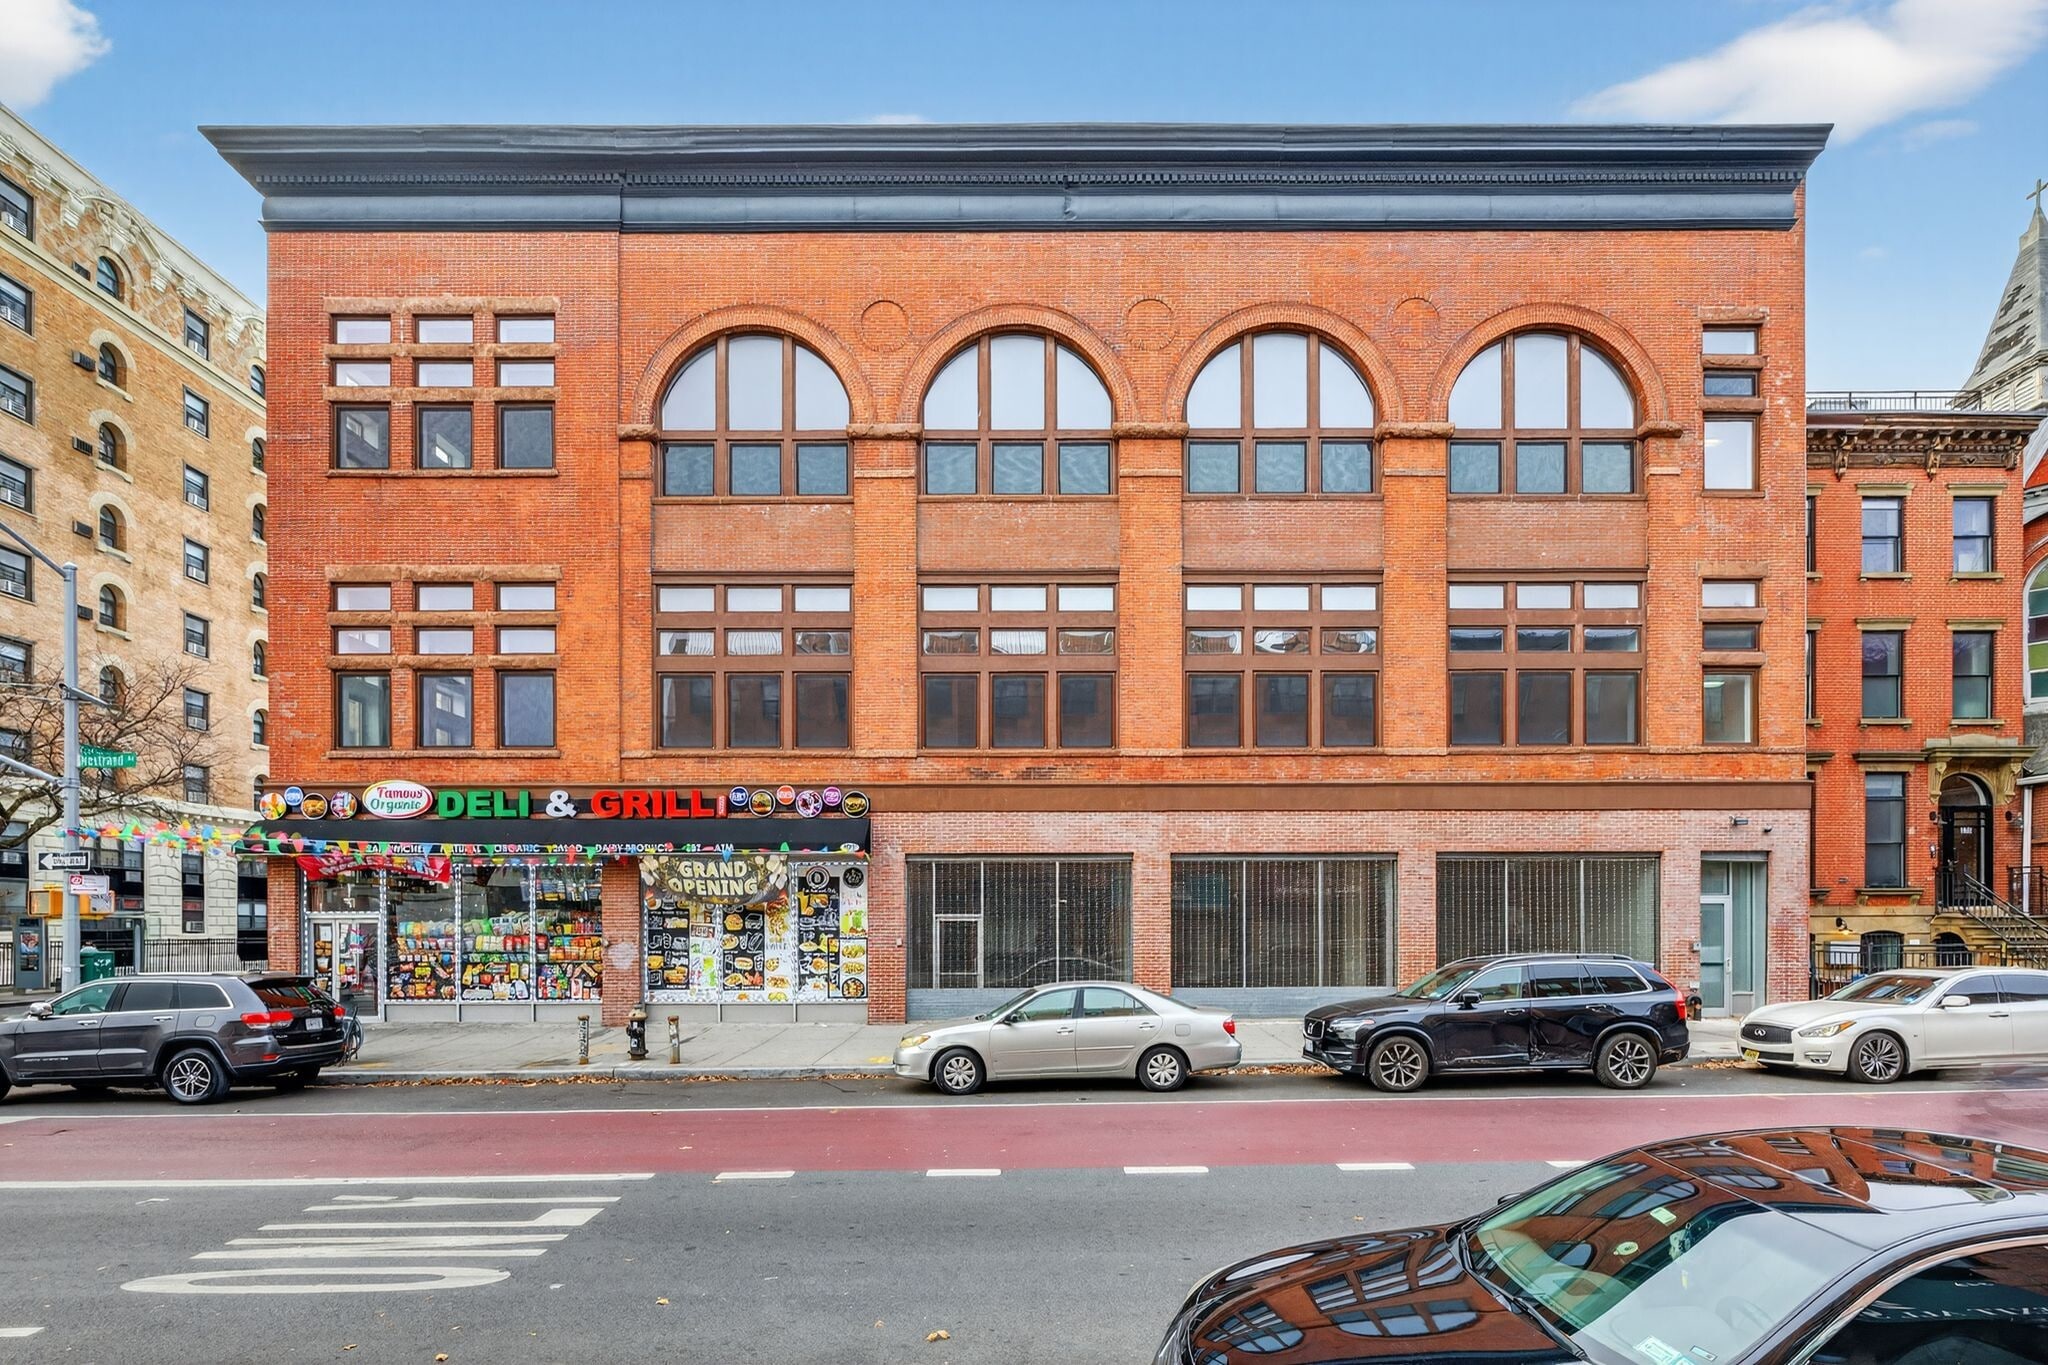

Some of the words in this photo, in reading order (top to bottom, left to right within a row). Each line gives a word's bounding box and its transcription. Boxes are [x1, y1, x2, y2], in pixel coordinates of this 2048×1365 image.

[377, 787, 423, 798] Famous
[438, 790, 529, 818] DELI
[545, 790, 579, 818] &
[591, 790, 715, 818] GRILL
[680, 861, 747, 878] GRAND
[668, 878, 758, 896] OPENING
